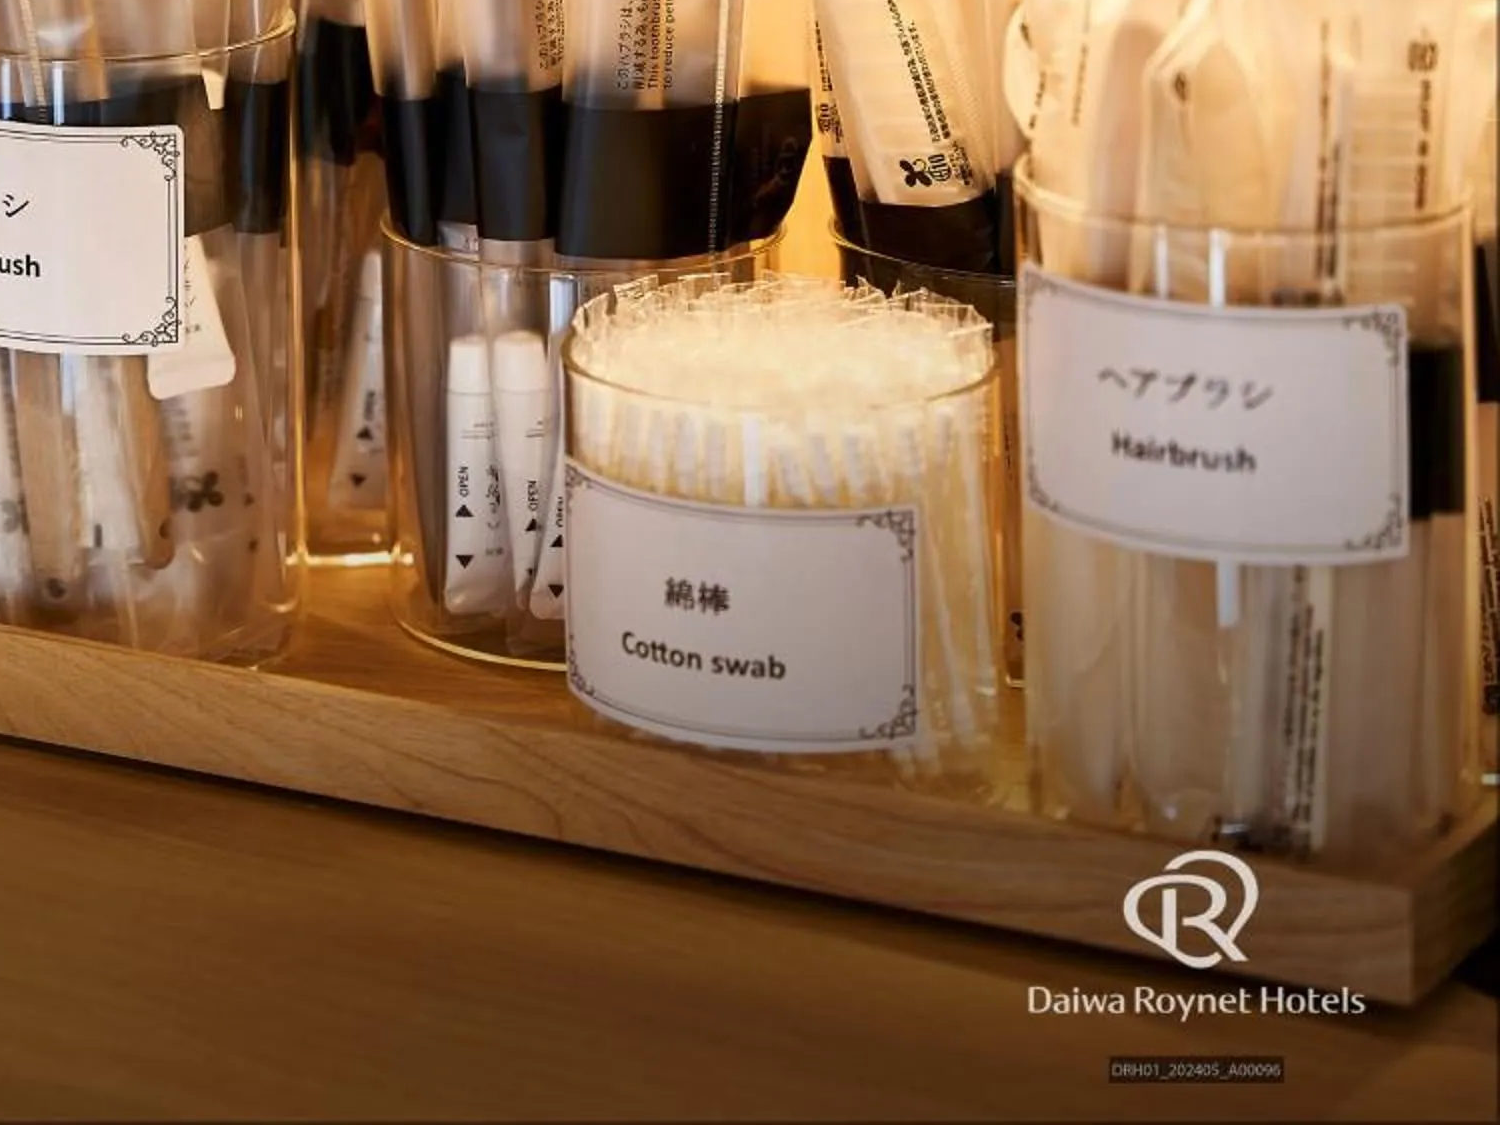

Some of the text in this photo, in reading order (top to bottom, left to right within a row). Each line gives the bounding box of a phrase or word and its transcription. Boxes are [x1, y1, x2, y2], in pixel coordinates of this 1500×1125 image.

[663, 27, 673, 74] reduce
[649, 64, 659, 89] This
[1097, 366, 1275, 410] ヘアブラシ
[1110, 429, 1258, 476] Hairbrush
[458, 466, 469, 497] OPEN
[527, 480, 538, 512] OPEN
[664, 577, 730, 615] 綿棒
[621, 631, 787, 681] Cotton swab
